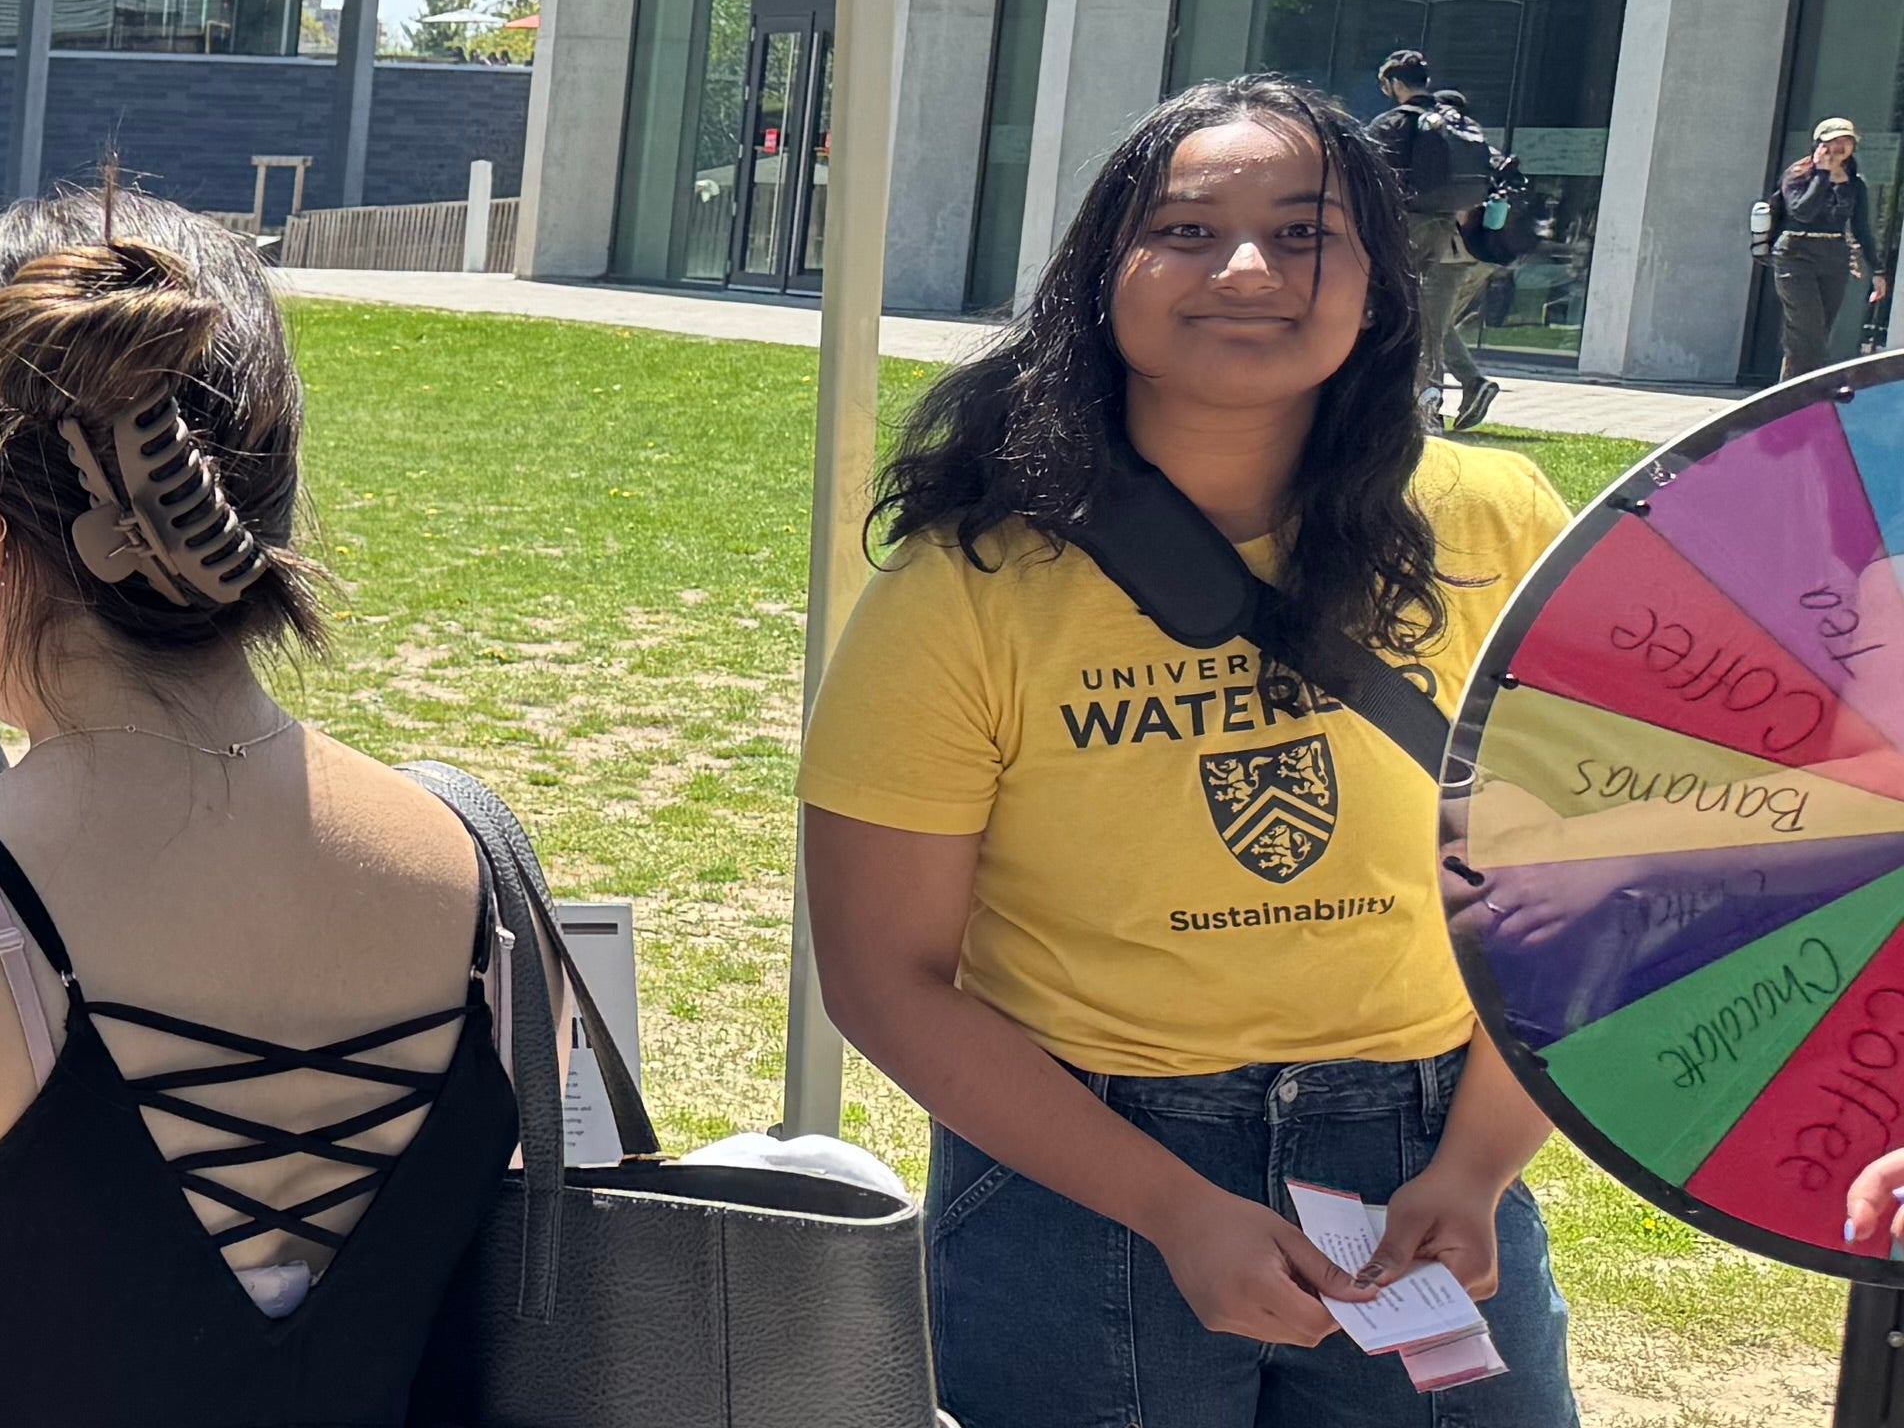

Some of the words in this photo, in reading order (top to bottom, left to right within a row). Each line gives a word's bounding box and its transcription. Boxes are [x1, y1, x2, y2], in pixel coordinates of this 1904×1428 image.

[1799, 585, 1888, 680] Tea
[1610, 608, 1824, 753] Coffee
[1570, 759, 1810, 833] Bananas
[1169, 894, 1396, 933] Sustainability
[1775, 987, 1904, 1193] Coffee
